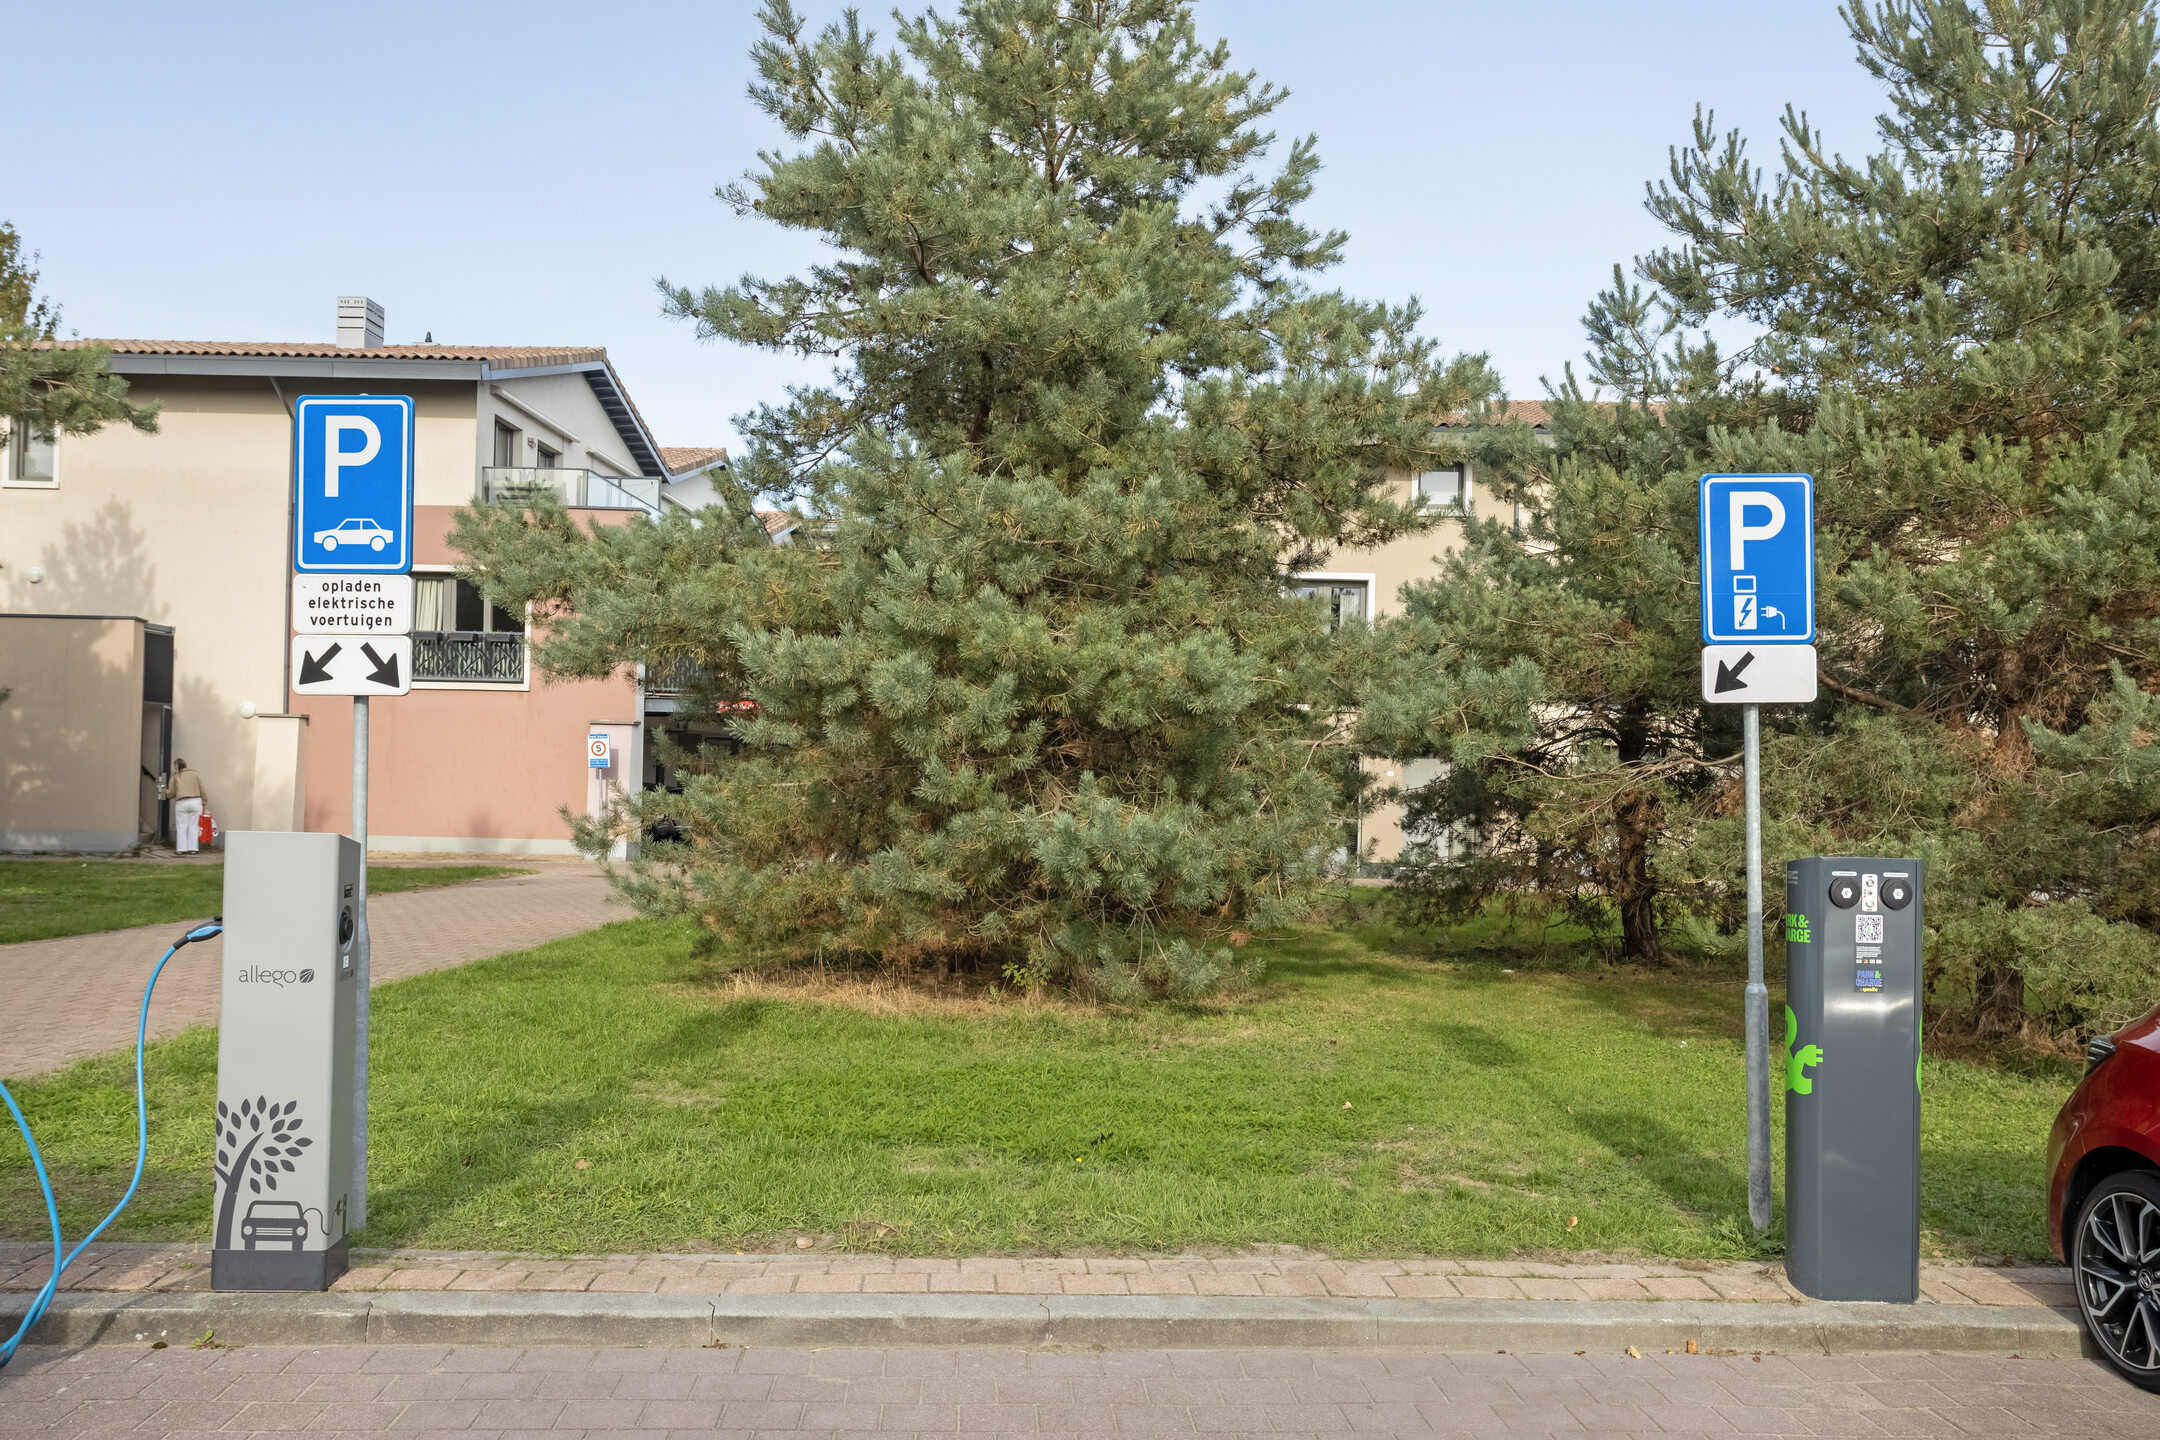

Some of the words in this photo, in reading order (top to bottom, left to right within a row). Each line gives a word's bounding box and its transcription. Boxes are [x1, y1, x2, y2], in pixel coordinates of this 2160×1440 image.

[325, 415, 381, 497] P
[1729, 491, 1786, 570] P
[322, 580, 381, 593] opladen
[308, 597, 395, 609] elektrische
[310, 614, 392, 628] voertuigen
[596, 744, 602, 752] 5
[1798, 914, 1809, 928] &
[238, 965, 297, 988] allego
[1857, 970, 1874, 978] PARK
